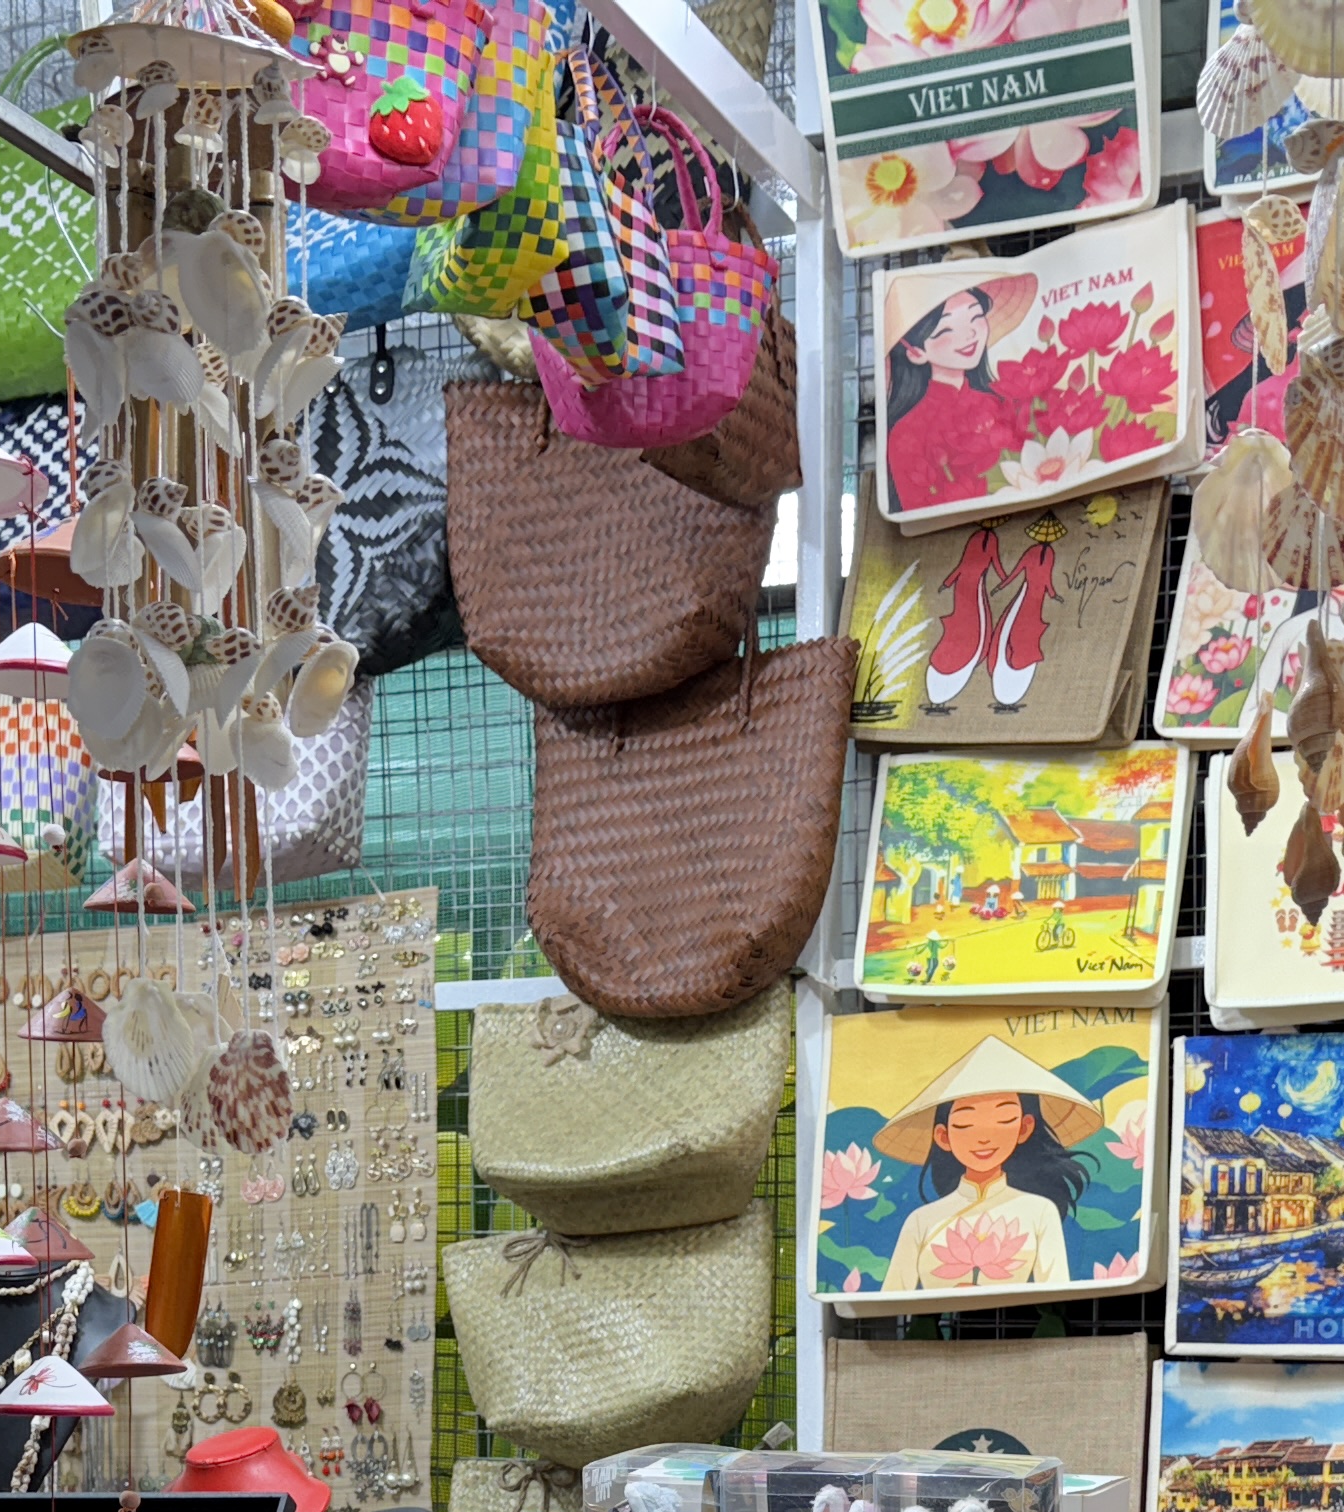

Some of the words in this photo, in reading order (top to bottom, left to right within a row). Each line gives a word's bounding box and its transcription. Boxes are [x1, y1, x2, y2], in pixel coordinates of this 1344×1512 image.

[908, 78, 973, 119] VIET
[980, 67, 1049, 106] NAM
[1040, 278, 1085, 309] VIET
[1087, 265, 1136, 294] NAM
[1076, 956, 1108, 974] Viet
[1110, 957, 1145, 973] Nam
[1003, 1011, 1064, 1037] VIET
[1069, 1005, 1137, 1029] NAM
